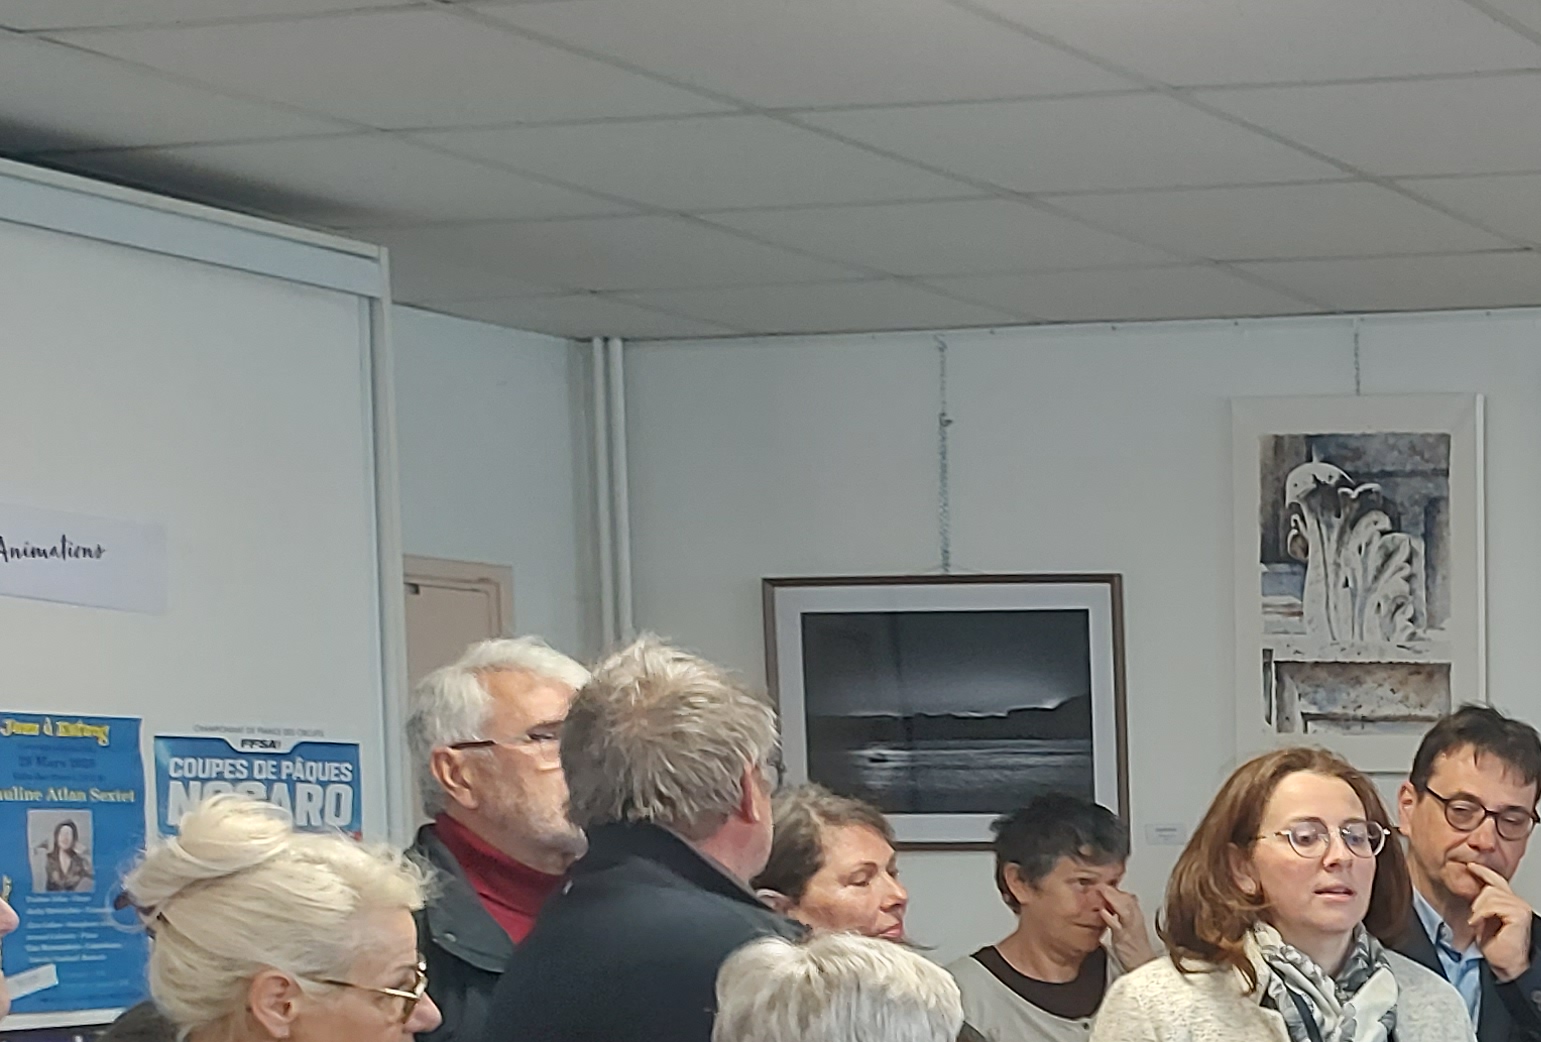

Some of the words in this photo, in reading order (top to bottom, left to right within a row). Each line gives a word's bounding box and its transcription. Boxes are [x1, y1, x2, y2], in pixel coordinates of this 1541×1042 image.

[169, 757, 249, 779] COUPES
[253, 759, 278, 780] DE
[281, 755, 353, 784] PÂQUES
[0, 785, 43, 801] uline
[168, 780, 354, 828] NARO
